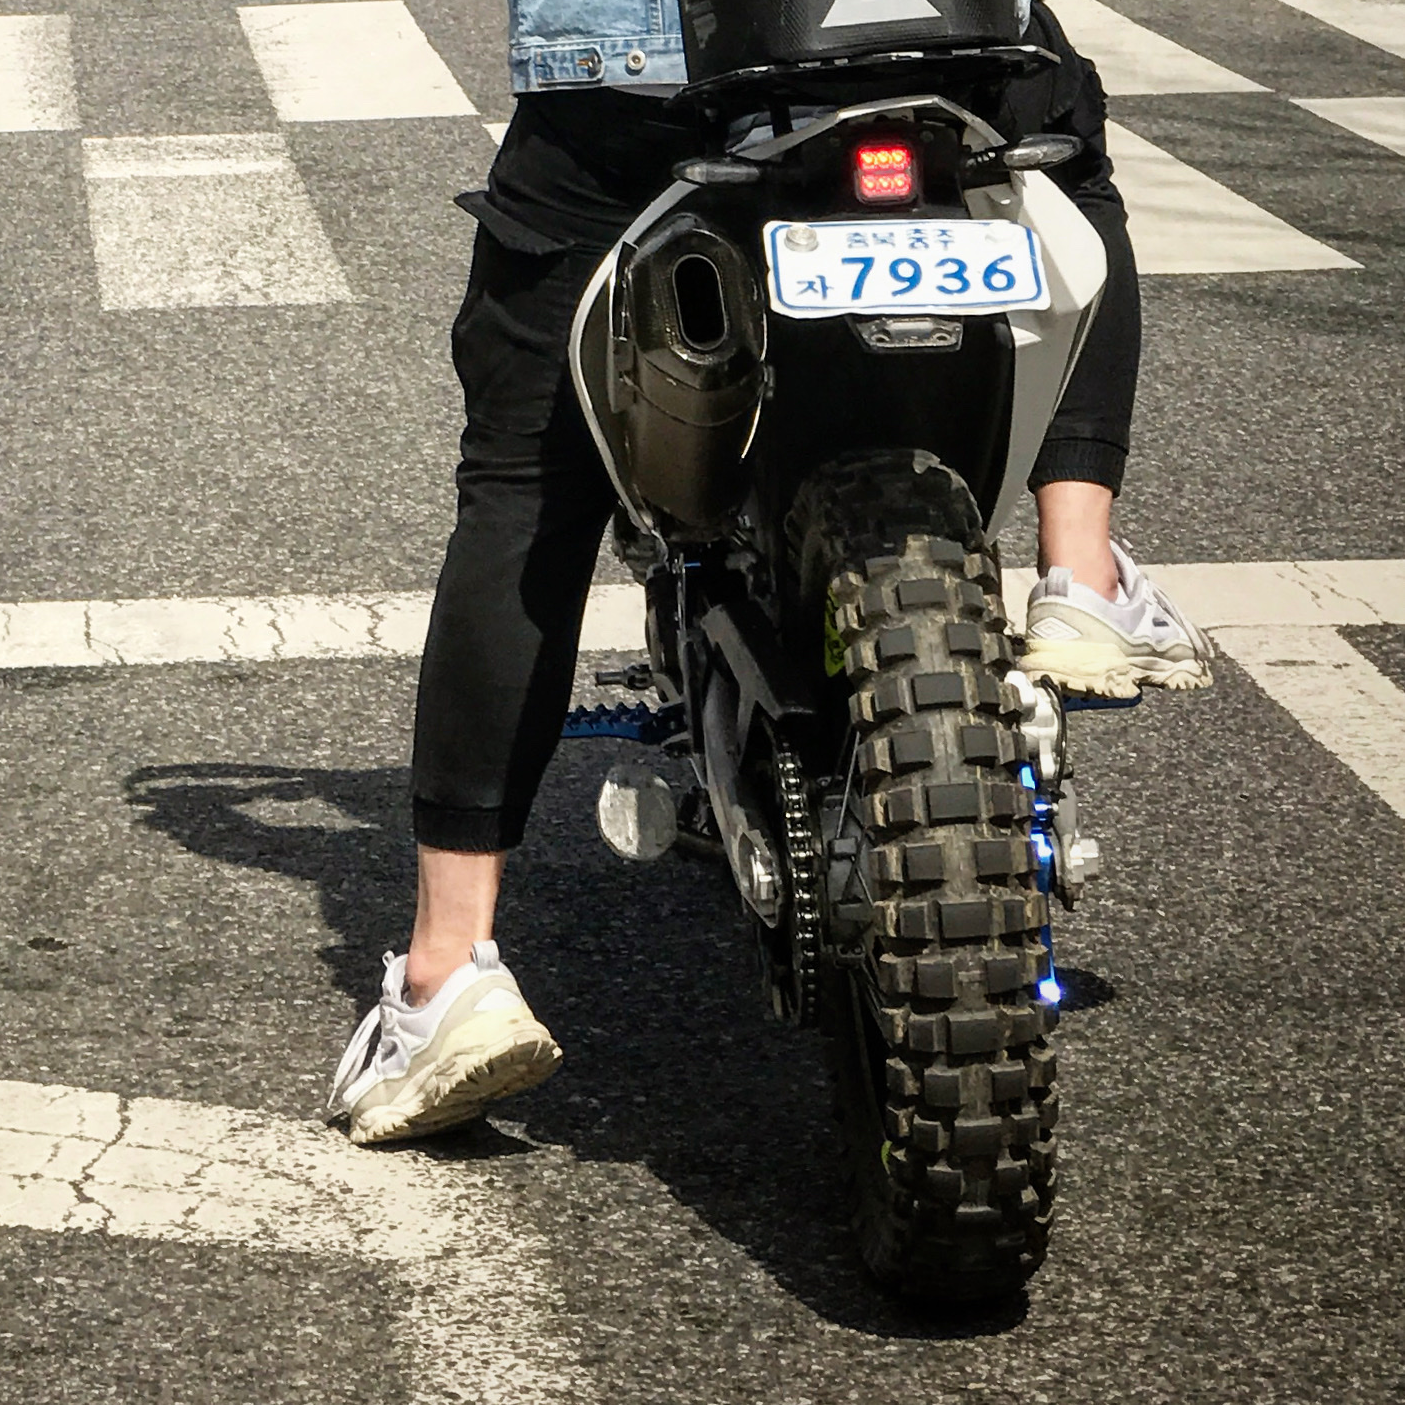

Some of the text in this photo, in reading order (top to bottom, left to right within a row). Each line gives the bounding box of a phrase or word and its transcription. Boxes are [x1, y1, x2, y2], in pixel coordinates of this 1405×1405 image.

[846, 228, 954, 250] 충북 충주
[796, 255, 1016, 301] 자7936
